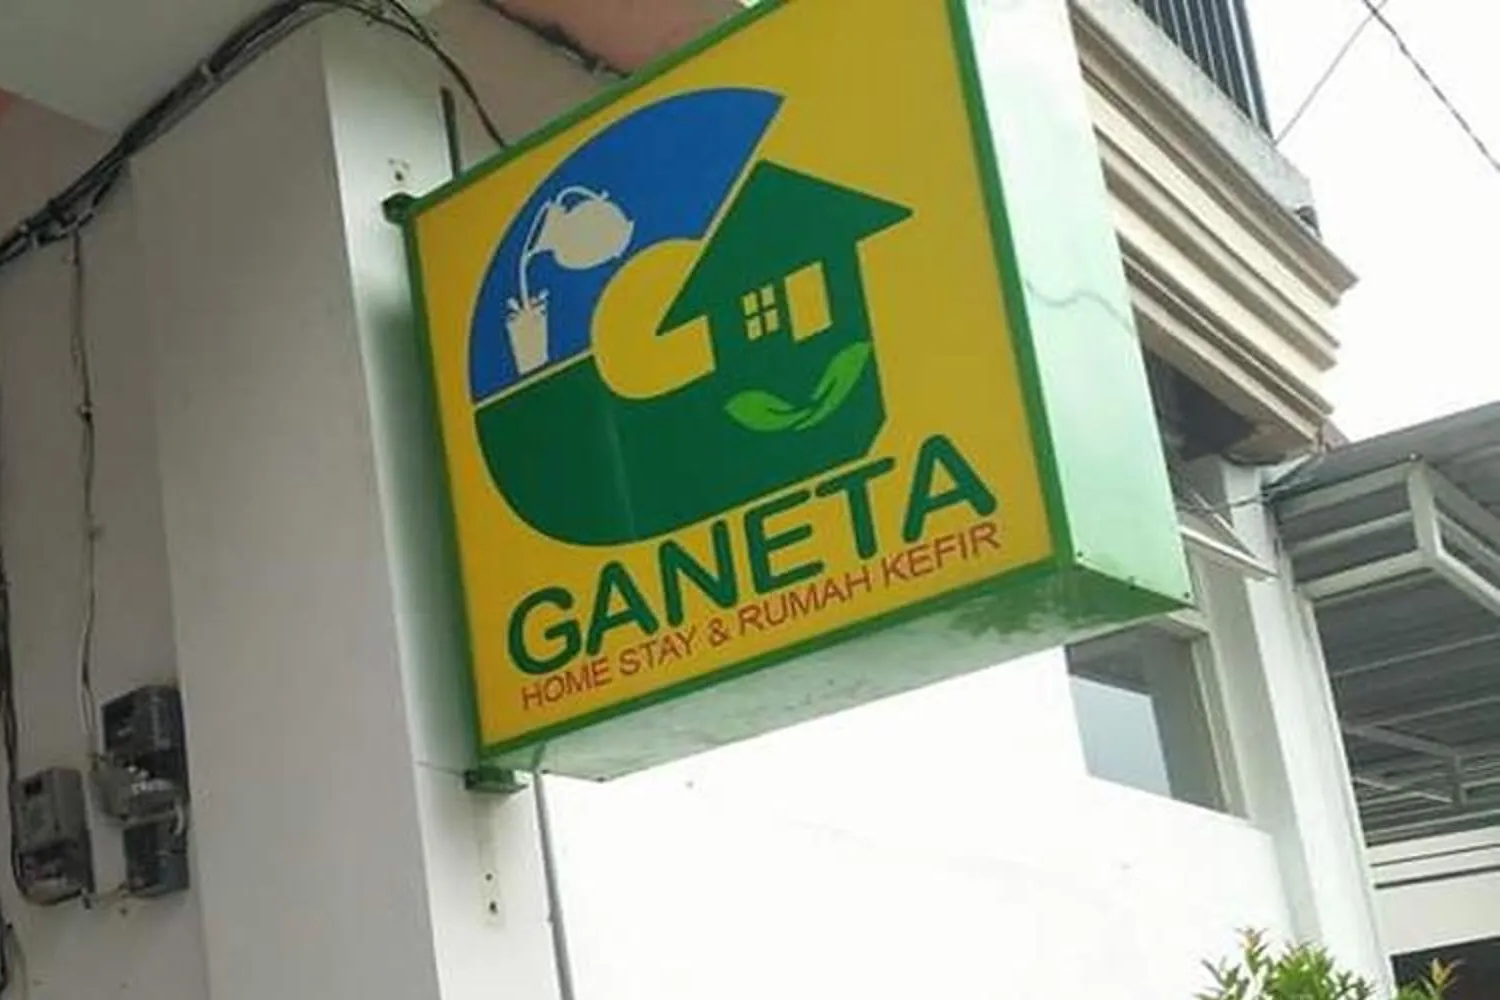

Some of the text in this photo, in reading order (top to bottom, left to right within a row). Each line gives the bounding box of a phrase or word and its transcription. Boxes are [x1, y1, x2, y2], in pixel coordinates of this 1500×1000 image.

[507, 433, 998, 676] GANETA
[521, 521, 1001, 711] HOME STAY & RUMAH KEFIR
